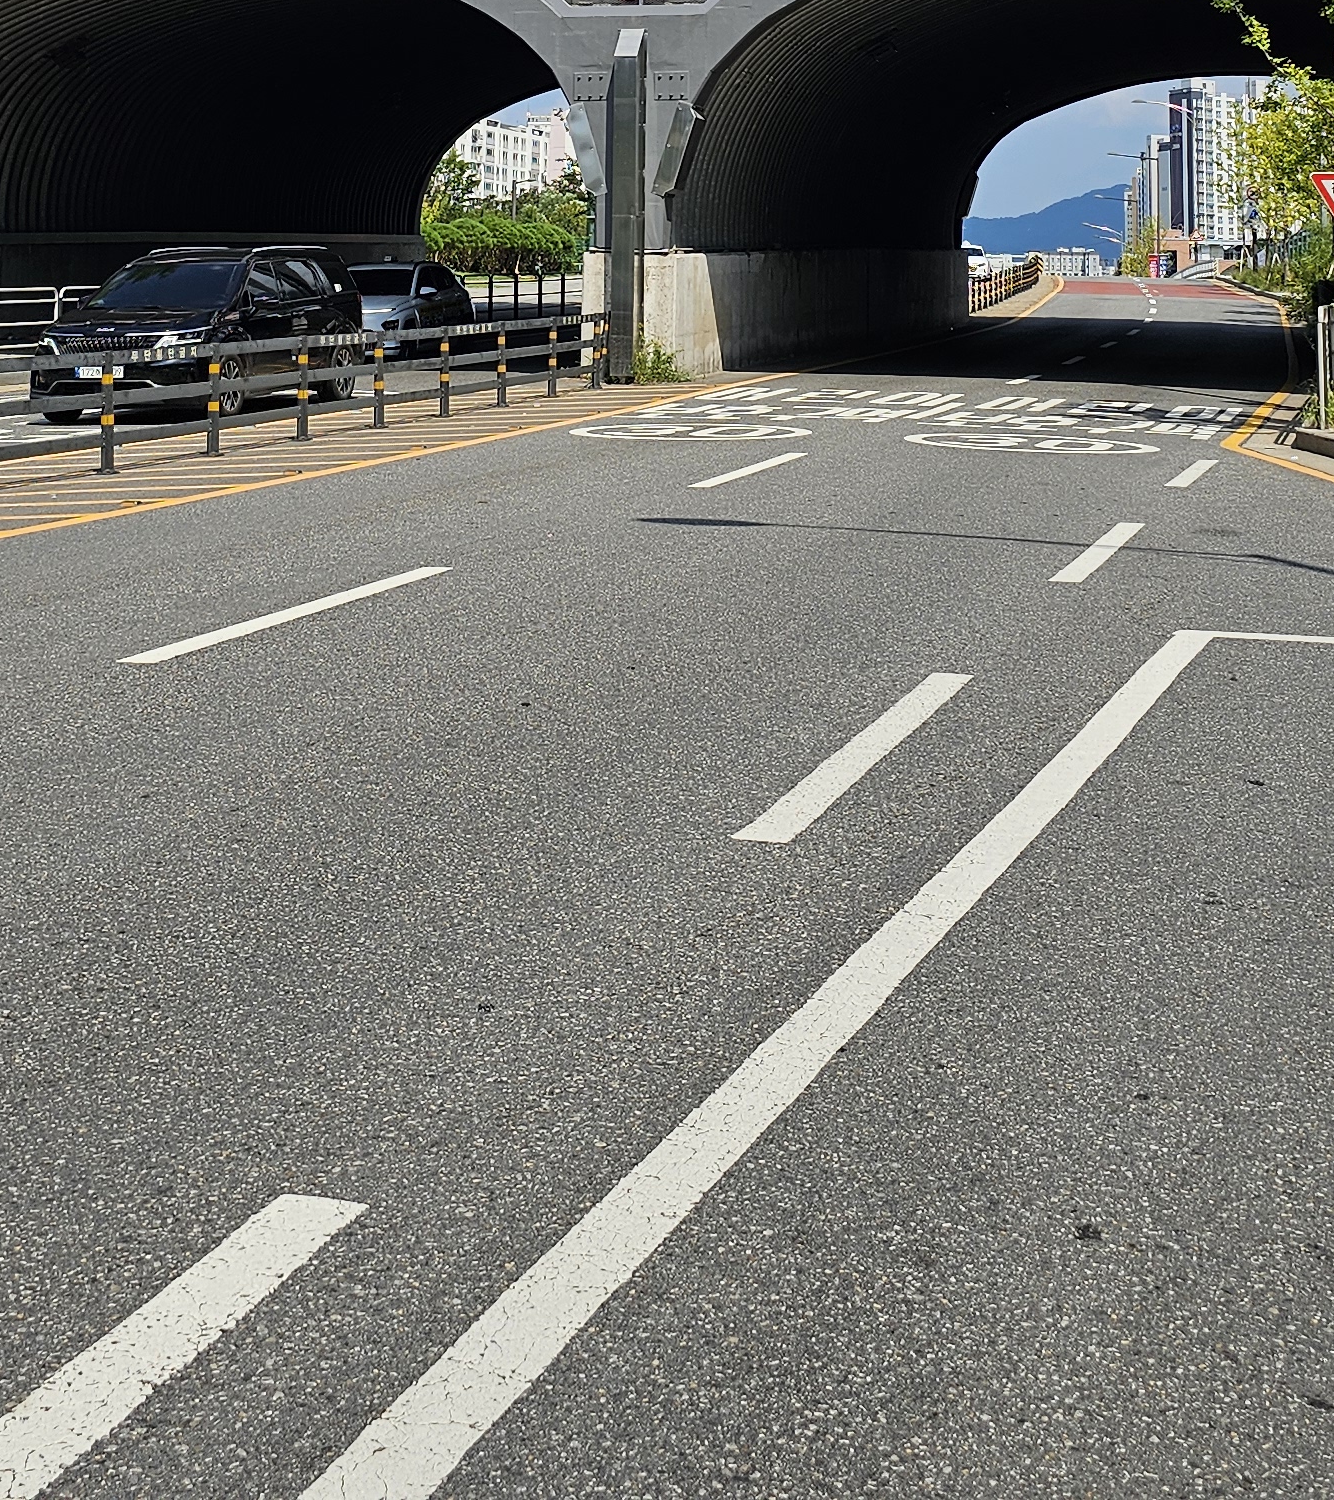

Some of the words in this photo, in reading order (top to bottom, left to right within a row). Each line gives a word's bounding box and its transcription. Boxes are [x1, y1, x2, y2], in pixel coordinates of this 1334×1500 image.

[695, 387, 965, 407] 어린이
[612, 403, 918, 423] 보호구역
[974, 396, 1244, 422] 어린이
[604, 425, 780, 437] 30
[917, 411, 1224, 440] 보호구역
[939, 435, 1115, 451] 30
